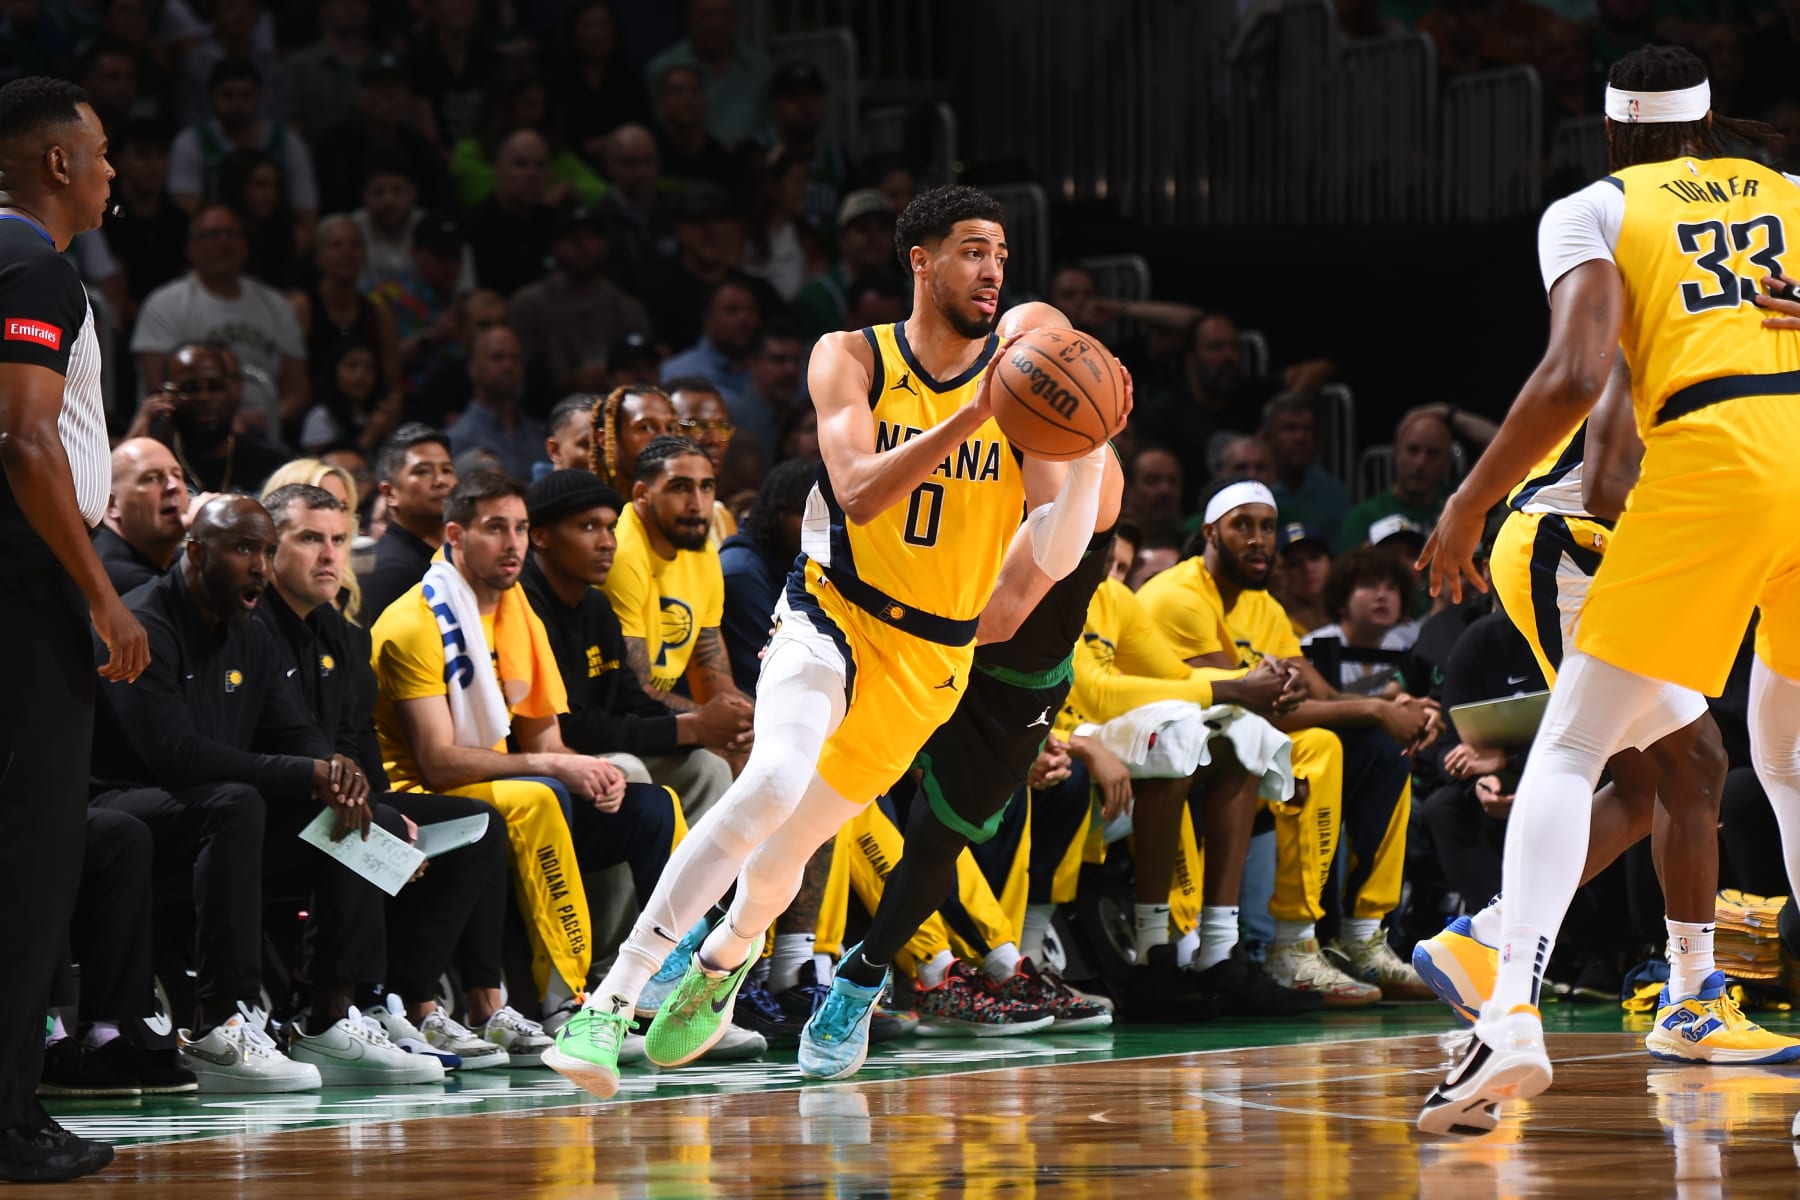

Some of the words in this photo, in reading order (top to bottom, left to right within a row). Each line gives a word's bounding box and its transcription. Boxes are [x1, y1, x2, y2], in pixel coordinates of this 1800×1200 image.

[1659, 175, 1759, 204] TURNER
[1676, 213, 1786, 315] 33
[10, 322, 57, 343] Emirates
[1010, 349, 1080, 421] Wilson
[903, 482, 944, 548] 0
[1317, 806, 1331, 856] INDIANA
[536, 844, 569, 901] INDIANA
[556, 904, 586, 955] PACERS
